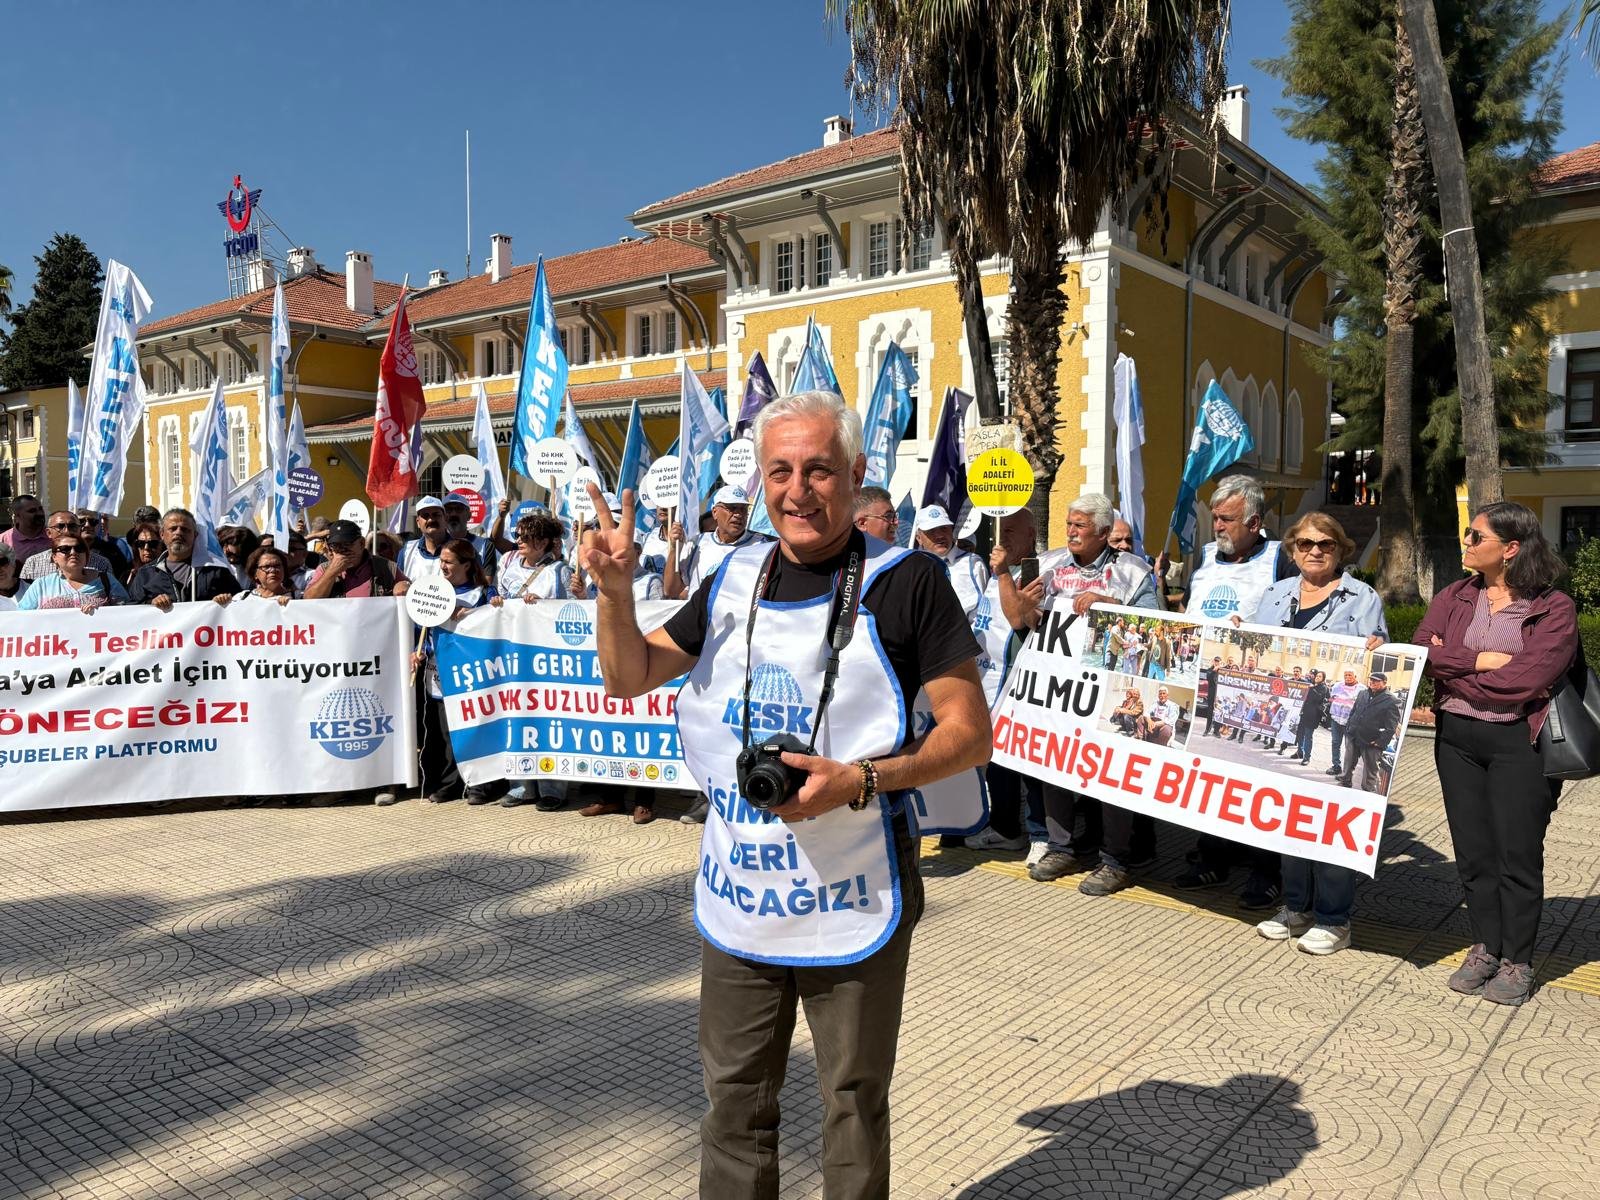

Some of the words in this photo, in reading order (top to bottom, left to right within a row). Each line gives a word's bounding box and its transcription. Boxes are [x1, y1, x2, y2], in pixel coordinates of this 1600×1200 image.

[991, 456, 998, 466] İL
[1000, 455, 1008, 466] İL
[983, 469, 1015, 479] ADALETİ
[968, 482, 1033, 493] ÖRGÜTLÜYORUZ!
[848, 551, 859, 573] EOS
[840, 574, 855, 616] DIGITAL
[1200, 599, 1241, 611] KESK
[89, 627, 183, 654] Teslim
[194, 623, 316, 648] Olmadık!
[555, 620, 593, 635] KESK
[66, 661, 163, 688] Adalet
[173, 656, 228, 686] İçin
[236, 655, 381, 684] Yürüyoruz!
[533, 652, 583, 678] GERİ
[309, 715, 395, 739] KESK
[721, 697, 813, 735] KESK
[95, 737, 218, 760] PLATFORMU
[336, 740, 370, 752] 1995
[1153, 757, 1381, 857] BİTECEK!
[729, 833, 799, 872] GERİ
[702, 853, 869, 918] ALACAĞIZ!
